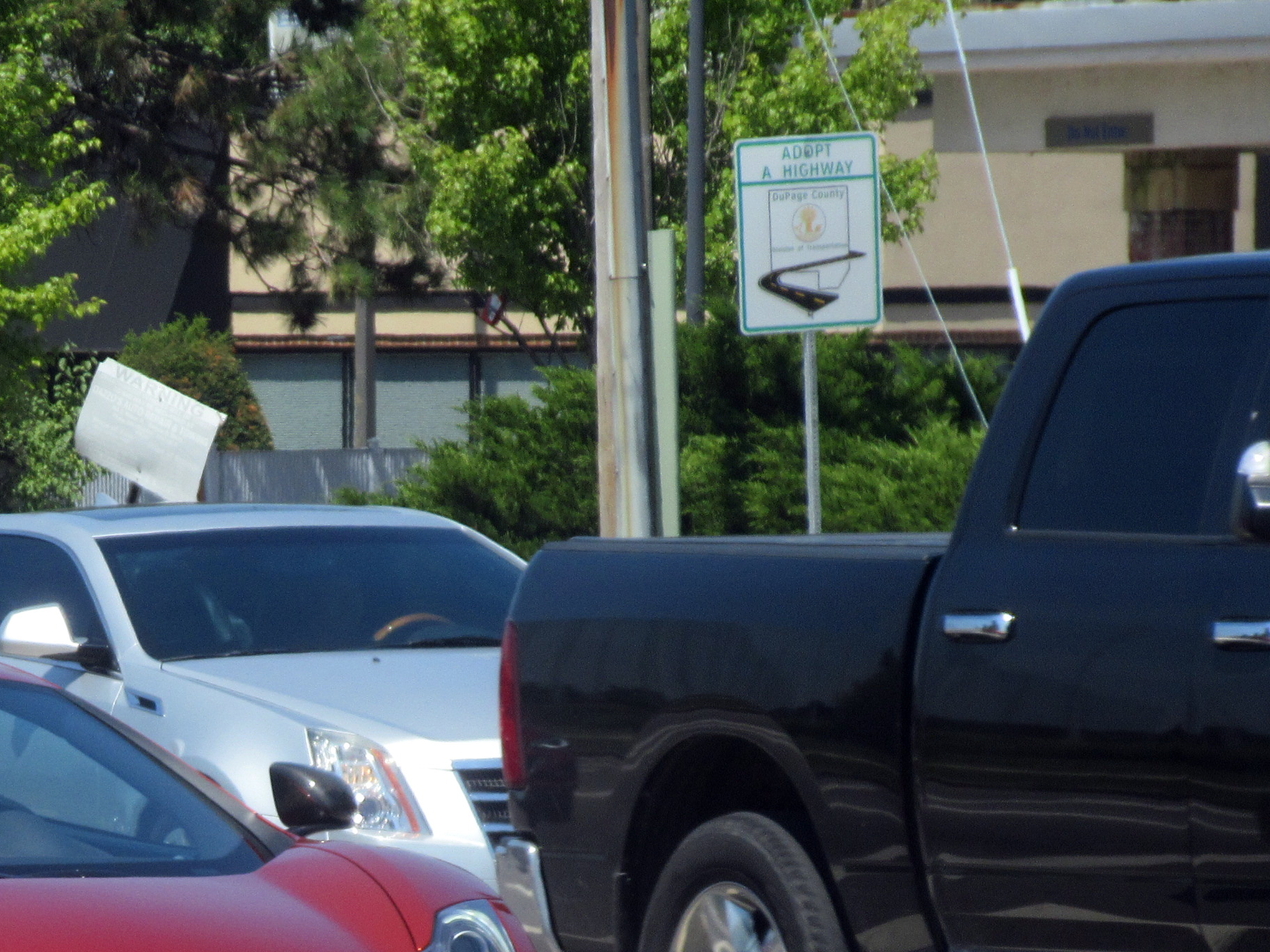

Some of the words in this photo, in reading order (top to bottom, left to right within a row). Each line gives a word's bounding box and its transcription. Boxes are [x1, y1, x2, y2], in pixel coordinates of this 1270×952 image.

[782, 143, 831, 160] ADOPT
[762, 165, 772, 179] A
[783, 160, 854, 178] HIGHWAY
[772, 192, 808, 202] DuPage
[811, 188, 845, 199] County
[115, 365, 205, 417] WARNING
